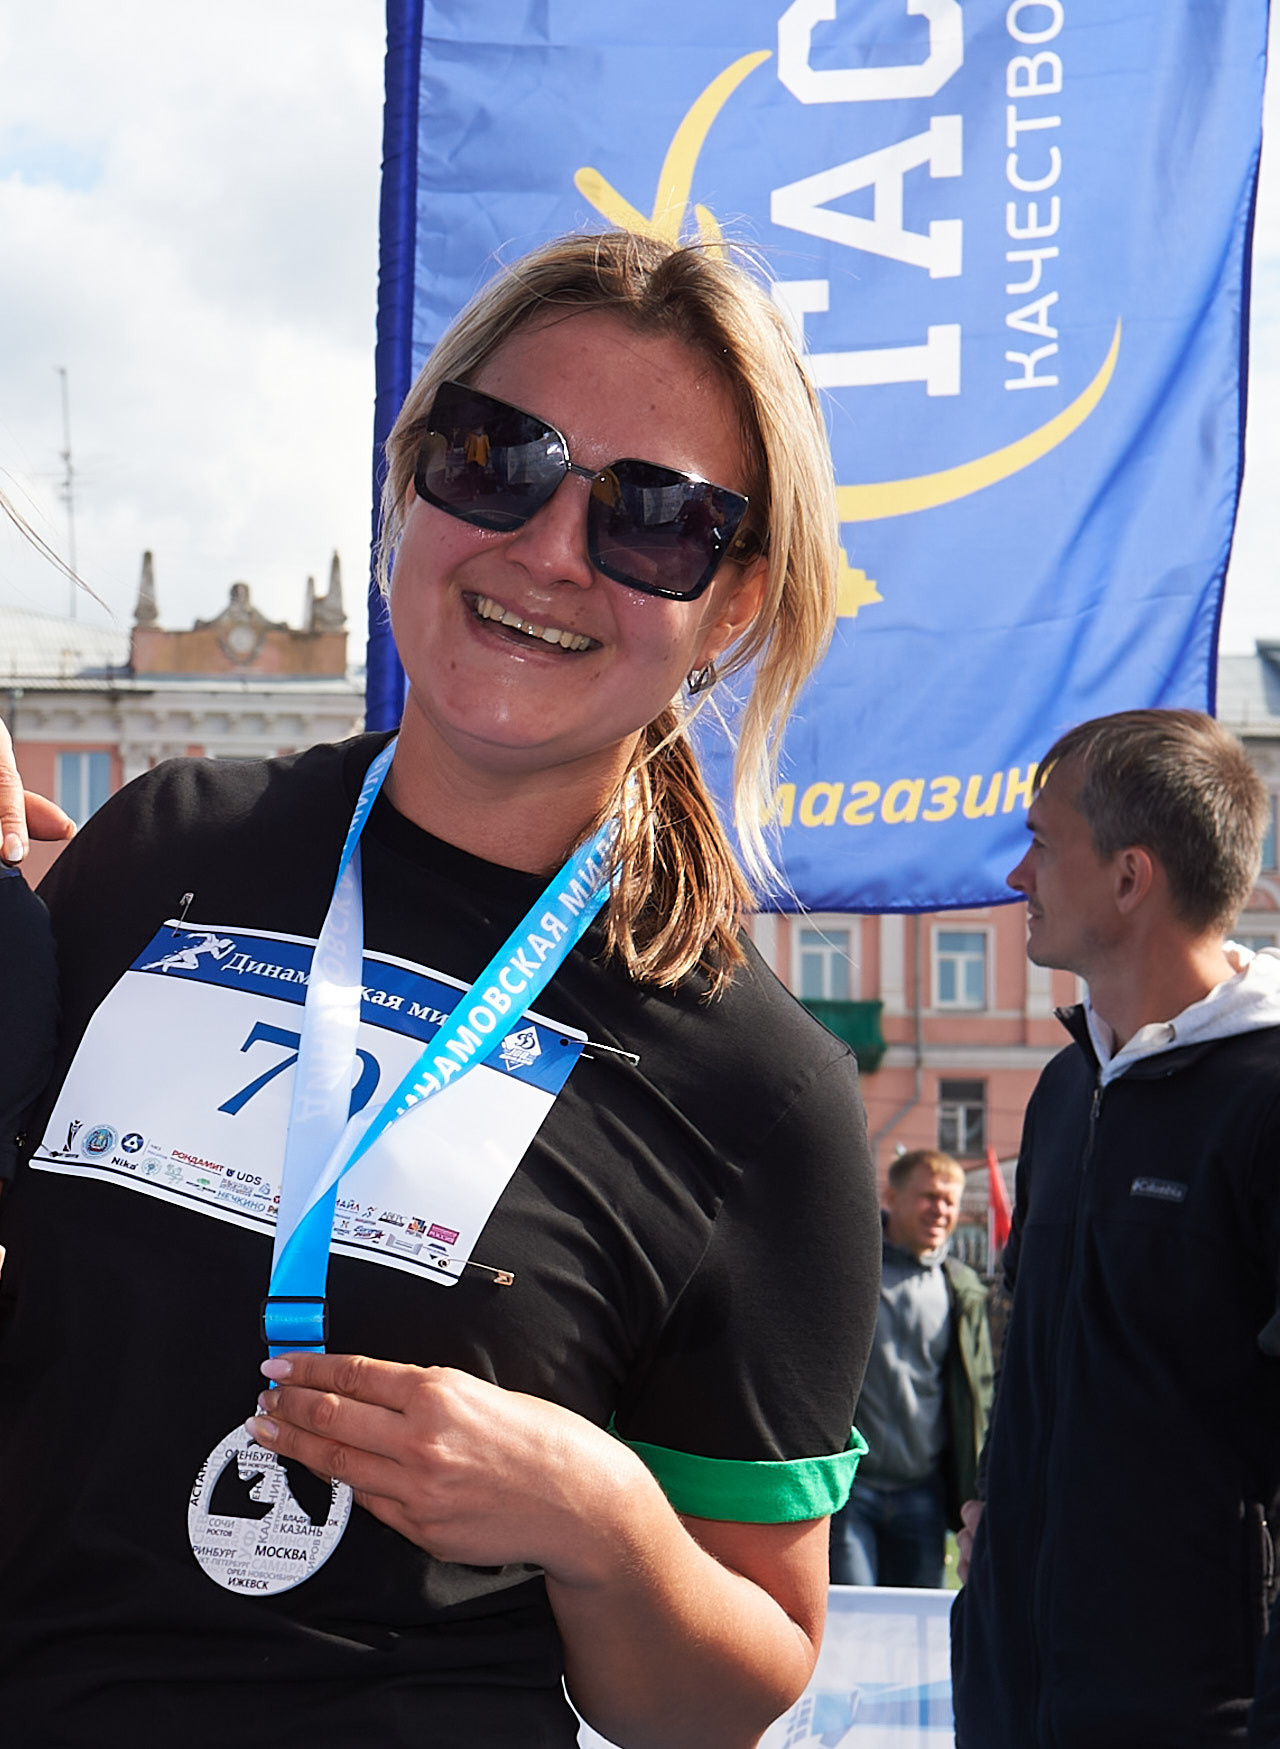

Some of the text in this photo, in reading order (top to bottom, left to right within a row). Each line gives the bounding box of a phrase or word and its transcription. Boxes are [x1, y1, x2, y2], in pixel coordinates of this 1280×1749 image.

[1004, 0, 1064, 391] КАЧЕСТВО
[760, 759, 1057, 828] магазин
[381, 911, 568, 1134] НАМОВСКАЯ
[111, 1156, 137, 1171] Nika
[236, 1171, 263, 1187] UDS
[208, 1518, 236, 1529] СОЧИ
[279, 1523, 323, 1537] КАЗАНЬ
[254, 1545, 308, 1562] МОСКВА
[228, 1576, 270, 1591] ИЖЕВСК
